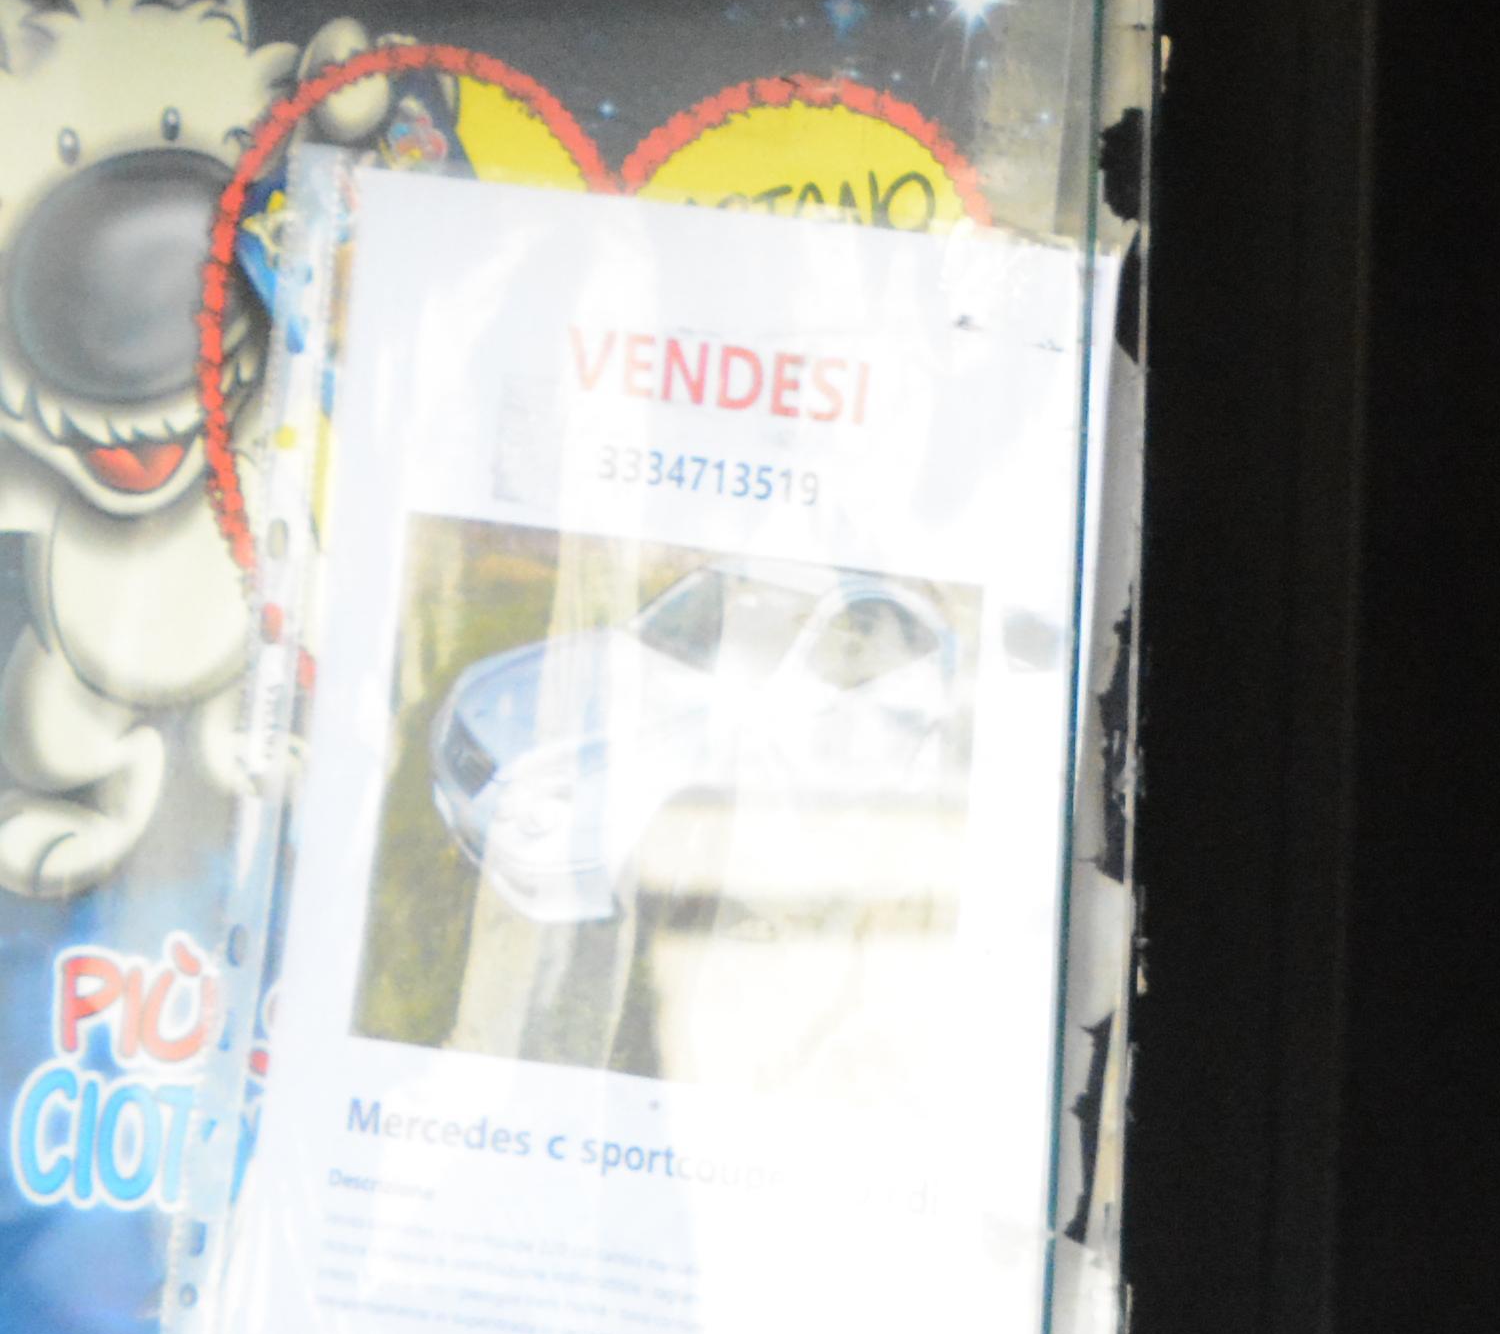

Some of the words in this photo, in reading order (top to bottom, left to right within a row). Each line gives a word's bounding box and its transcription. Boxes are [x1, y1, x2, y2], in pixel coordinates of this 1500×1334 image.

[567, 324, 871, 425] VENDESI
[596, 445, 820, 508] 3334713519
[61, 939, 220, 1063] PIÙ
[345, 1096, 532, 1156] Mercedes
